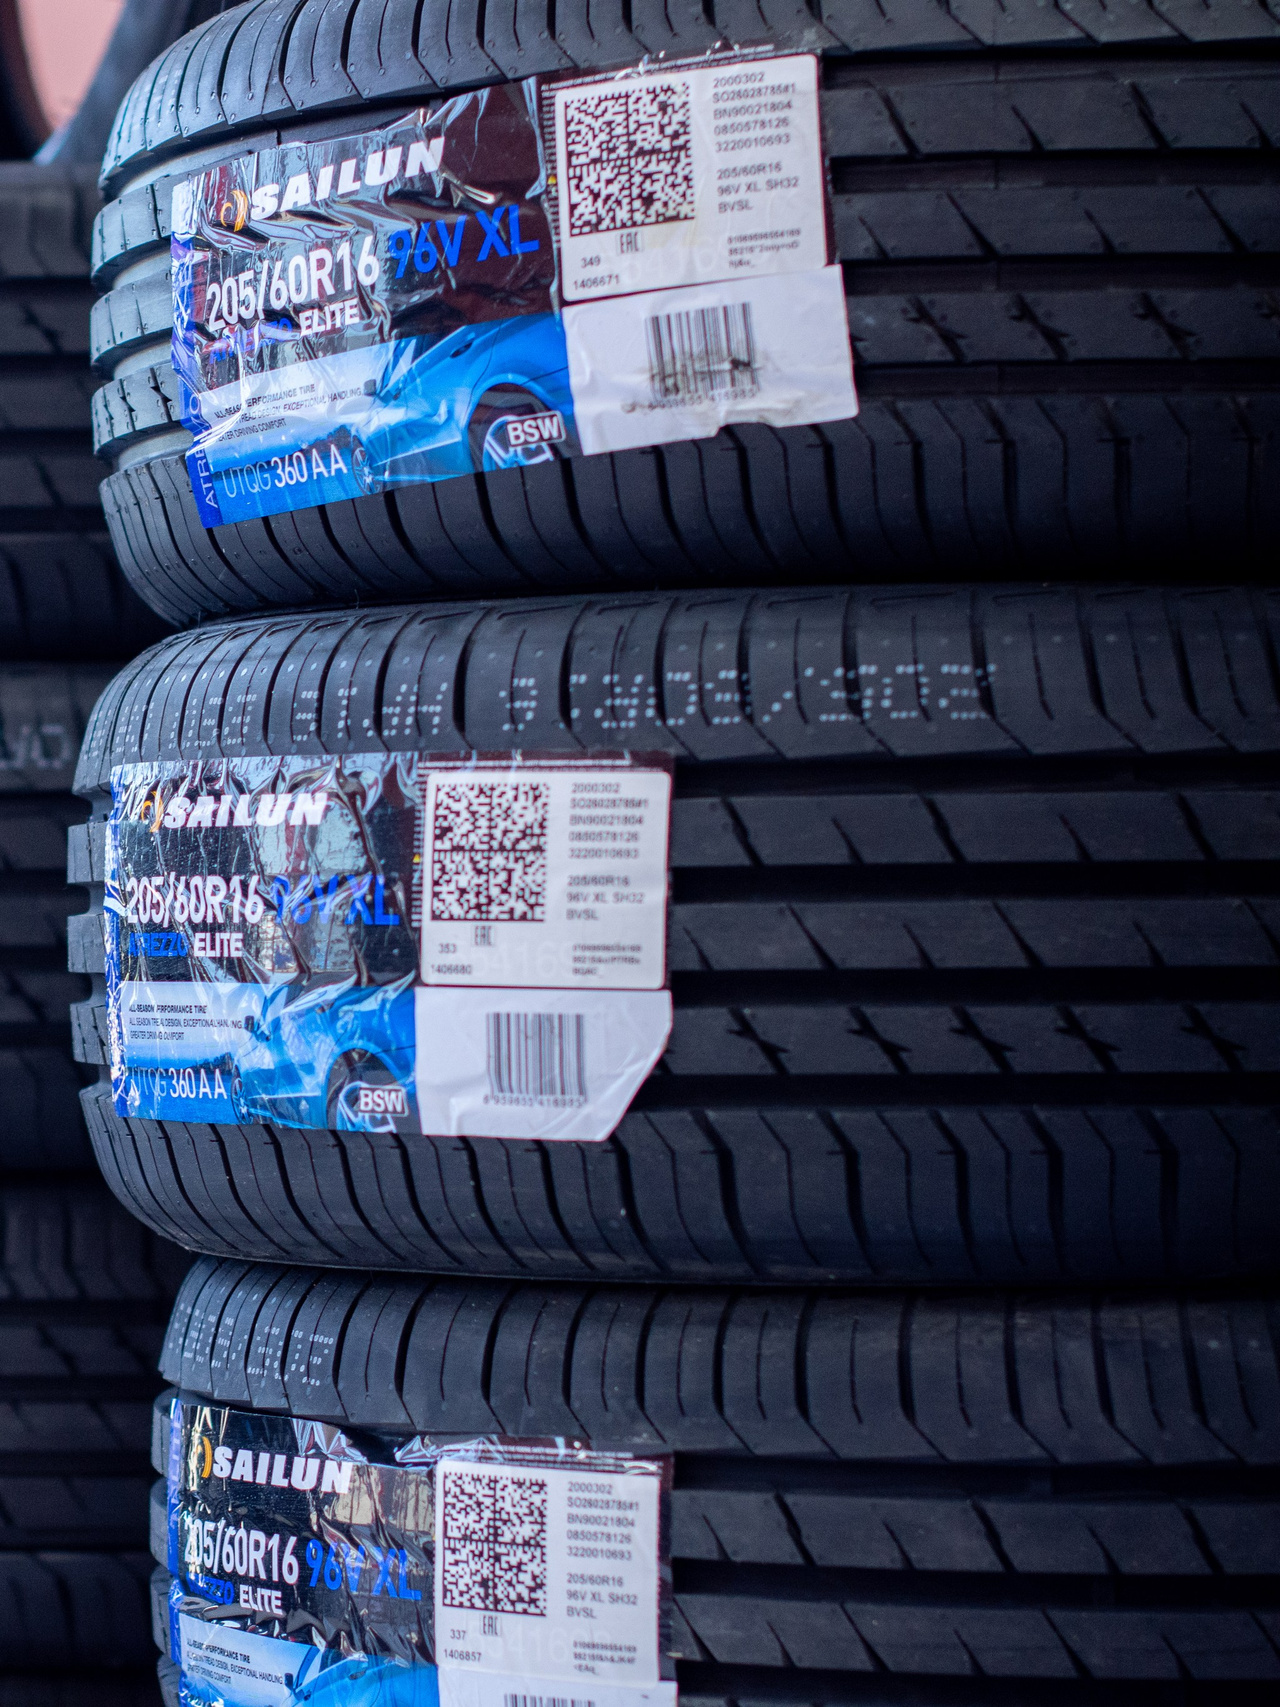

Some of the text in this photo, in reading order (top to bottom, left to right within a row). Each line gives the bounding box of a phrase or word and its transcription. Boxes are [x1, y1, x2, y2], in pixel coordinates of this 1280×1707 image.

[713, 71, 765, 89] 2000302
[252, 136, 445, 218] SAILUN
[745, 181, 761, 194] XL
[206, 234, 381, 332] 205/60R16
[388, 214, 468, 280] 96V
[477, 204, 540, 262] XL
[581, 255, 601, 269] 349
[299, 299, 361, 337] ELITE
[245, 390, 298, 408] ERFORMANCE
[299, 384, 316, 396] TIRE
[236, 425, 258, 438] DRIVING
[258, 418, 287, 433] COMFORT
[508, 414, 562, 446] BSW
[222, 463, 272, 499] UTQG
[271, 451, 309, 489] 360
[164, 790, 329, 830] SAILUN
[126, 872, 265, 928] 205/60R16
[344, 873, 401, 926] XL
[193, 932, 244, 958] ELITE
[439, 943, 457, 954] 353
[193, 1005, 208, 1014] TIRE
[168, 1068, 197, 1098] 360
[358, 1087, 405, 1114] BSW
[213, 1445, 354, 1494] SAILUN
[568, 1481, 613, 1495] 2000302
[184, 1517, 423, 1601] 205/60R16 96V XL
[566, 1573, 623, 1588] 205/60R16
[239, 1584, 283, 1616] ELITE
[566, 1590, 587, 1602] 96V
[590, 1591, 604, 1603] XL
[450, 1628, 467, 1641] 337
[239, 1653, 251, 1664] TIRE
[444, 1648, 482, 1662] 1406857
[230, 1663, 259, 1680] EXCEPTIONAL
